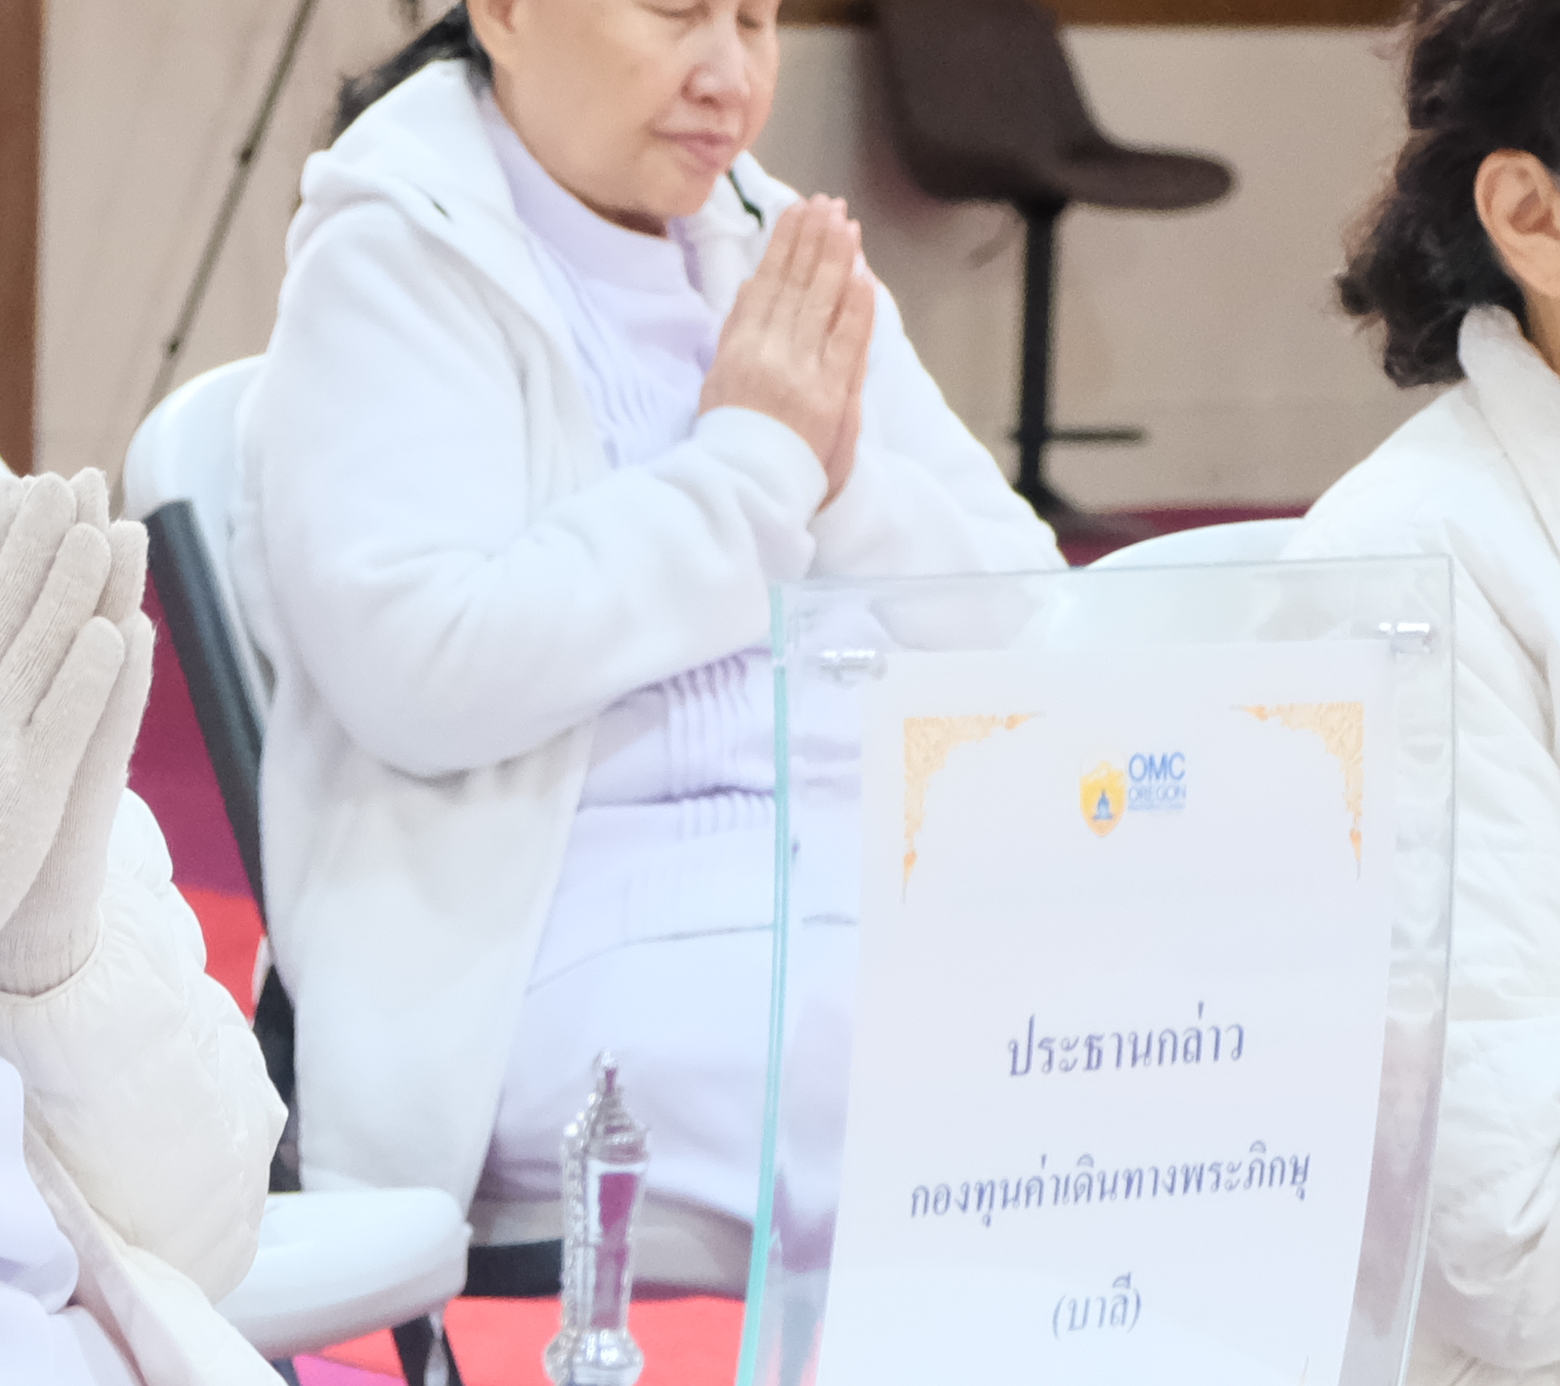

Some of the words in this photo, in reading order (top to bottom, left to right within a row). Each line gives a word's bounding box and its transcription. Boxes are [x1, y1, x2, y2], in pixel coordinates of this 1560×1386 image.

[1128, 751, 1187, 782] OMC
[1007, 999, 1247, 1079] ประธานกล่าว
[909, 1138, 1312, 1229] กองทุนค่าเดินทางพระภิกษุ
[1050, 1270, 1144, 1340] (บาลี)
